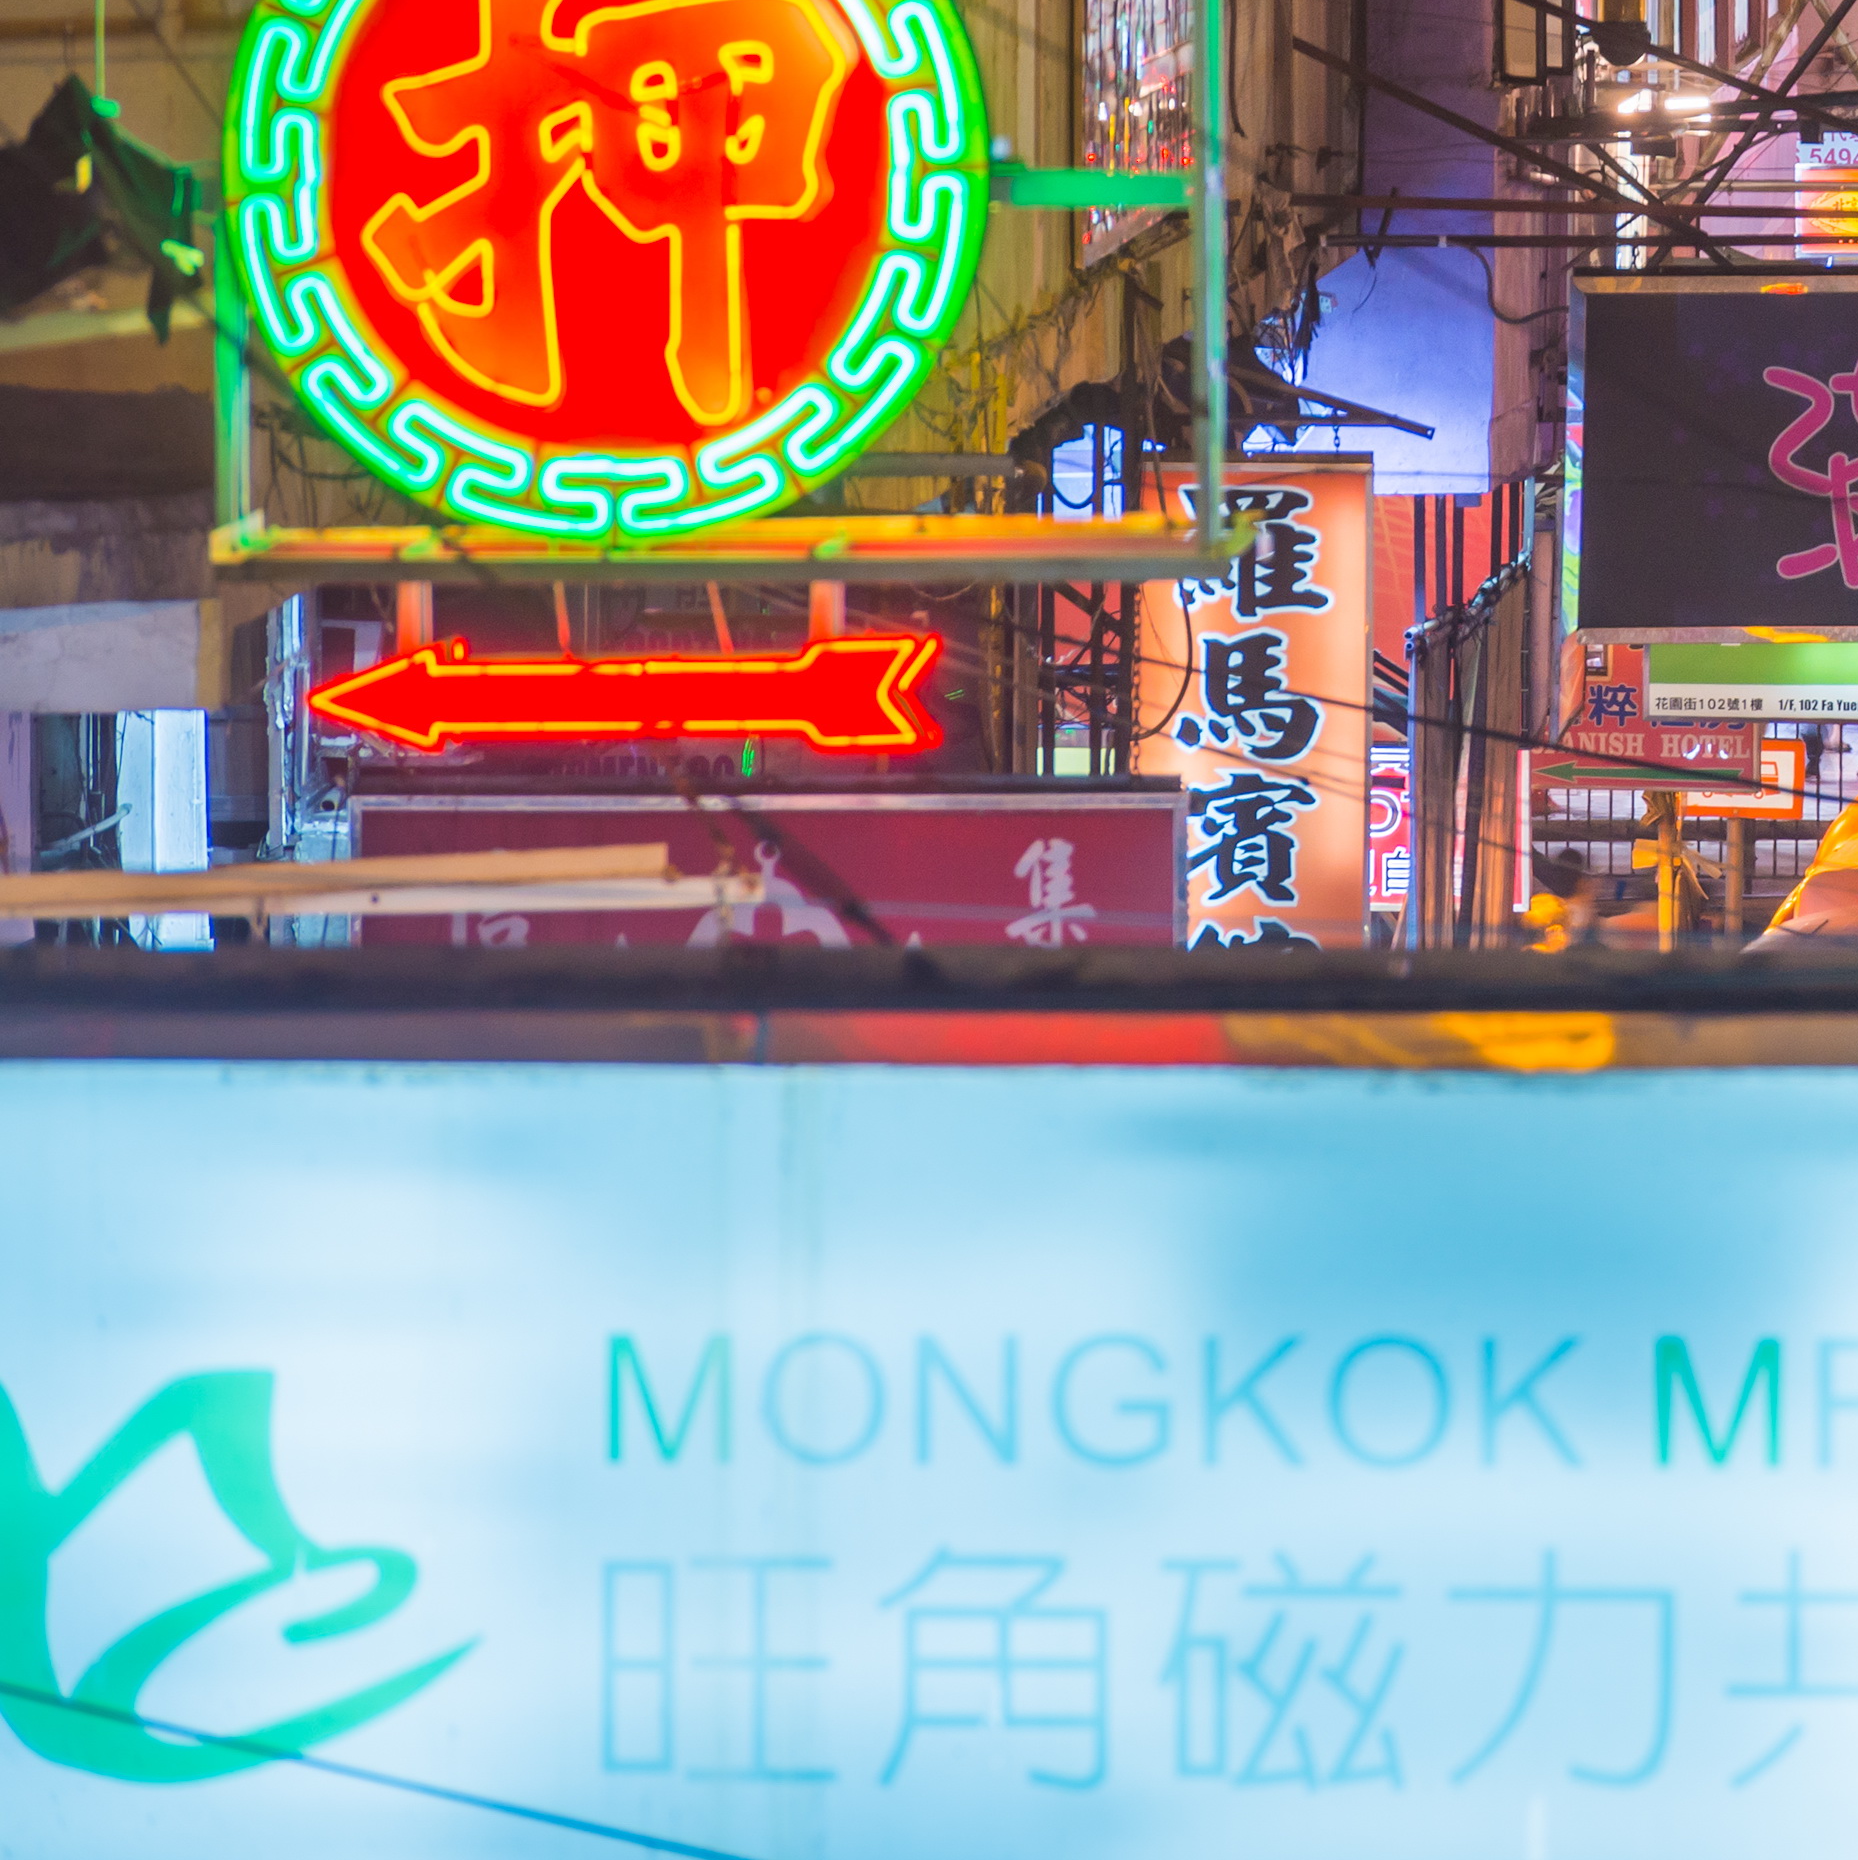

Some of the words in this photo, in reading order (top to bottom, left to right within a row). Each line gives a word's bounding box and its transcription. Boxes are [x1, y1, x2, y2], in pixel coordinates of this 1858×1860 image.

[1175, 484, 1335, 951] 羅馬賓
[1660, 732, 1750, 758] HOTEL
[1799, 698, 1818, 713] 102
[1821, 698, 1834, 713] Fa
[603, 1332, 1585, 1476] MONGKOK
